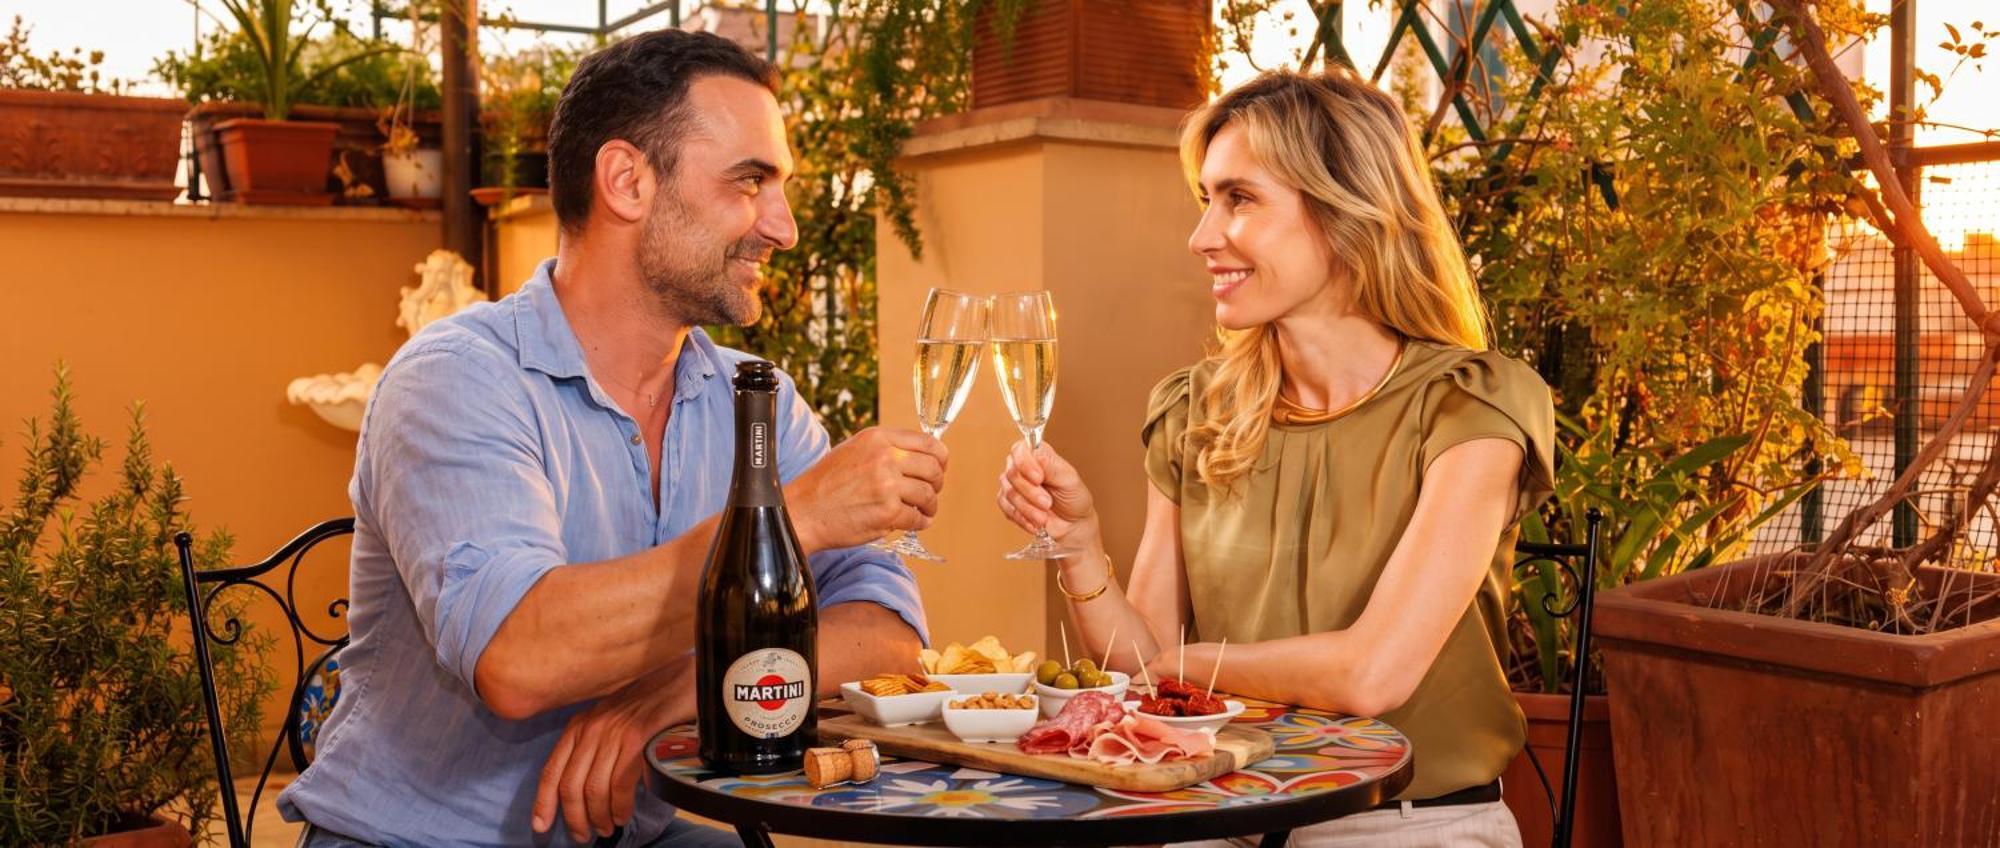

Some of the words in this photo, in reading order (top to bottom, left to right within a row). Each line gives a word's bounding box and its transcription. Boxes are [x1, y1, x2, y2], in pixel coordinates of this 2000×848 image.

[754, 426, 763, 465] MARTINI
[736, 682, 802, 700] MARTINI
[744, 714, 797, 730] PROSECCO
